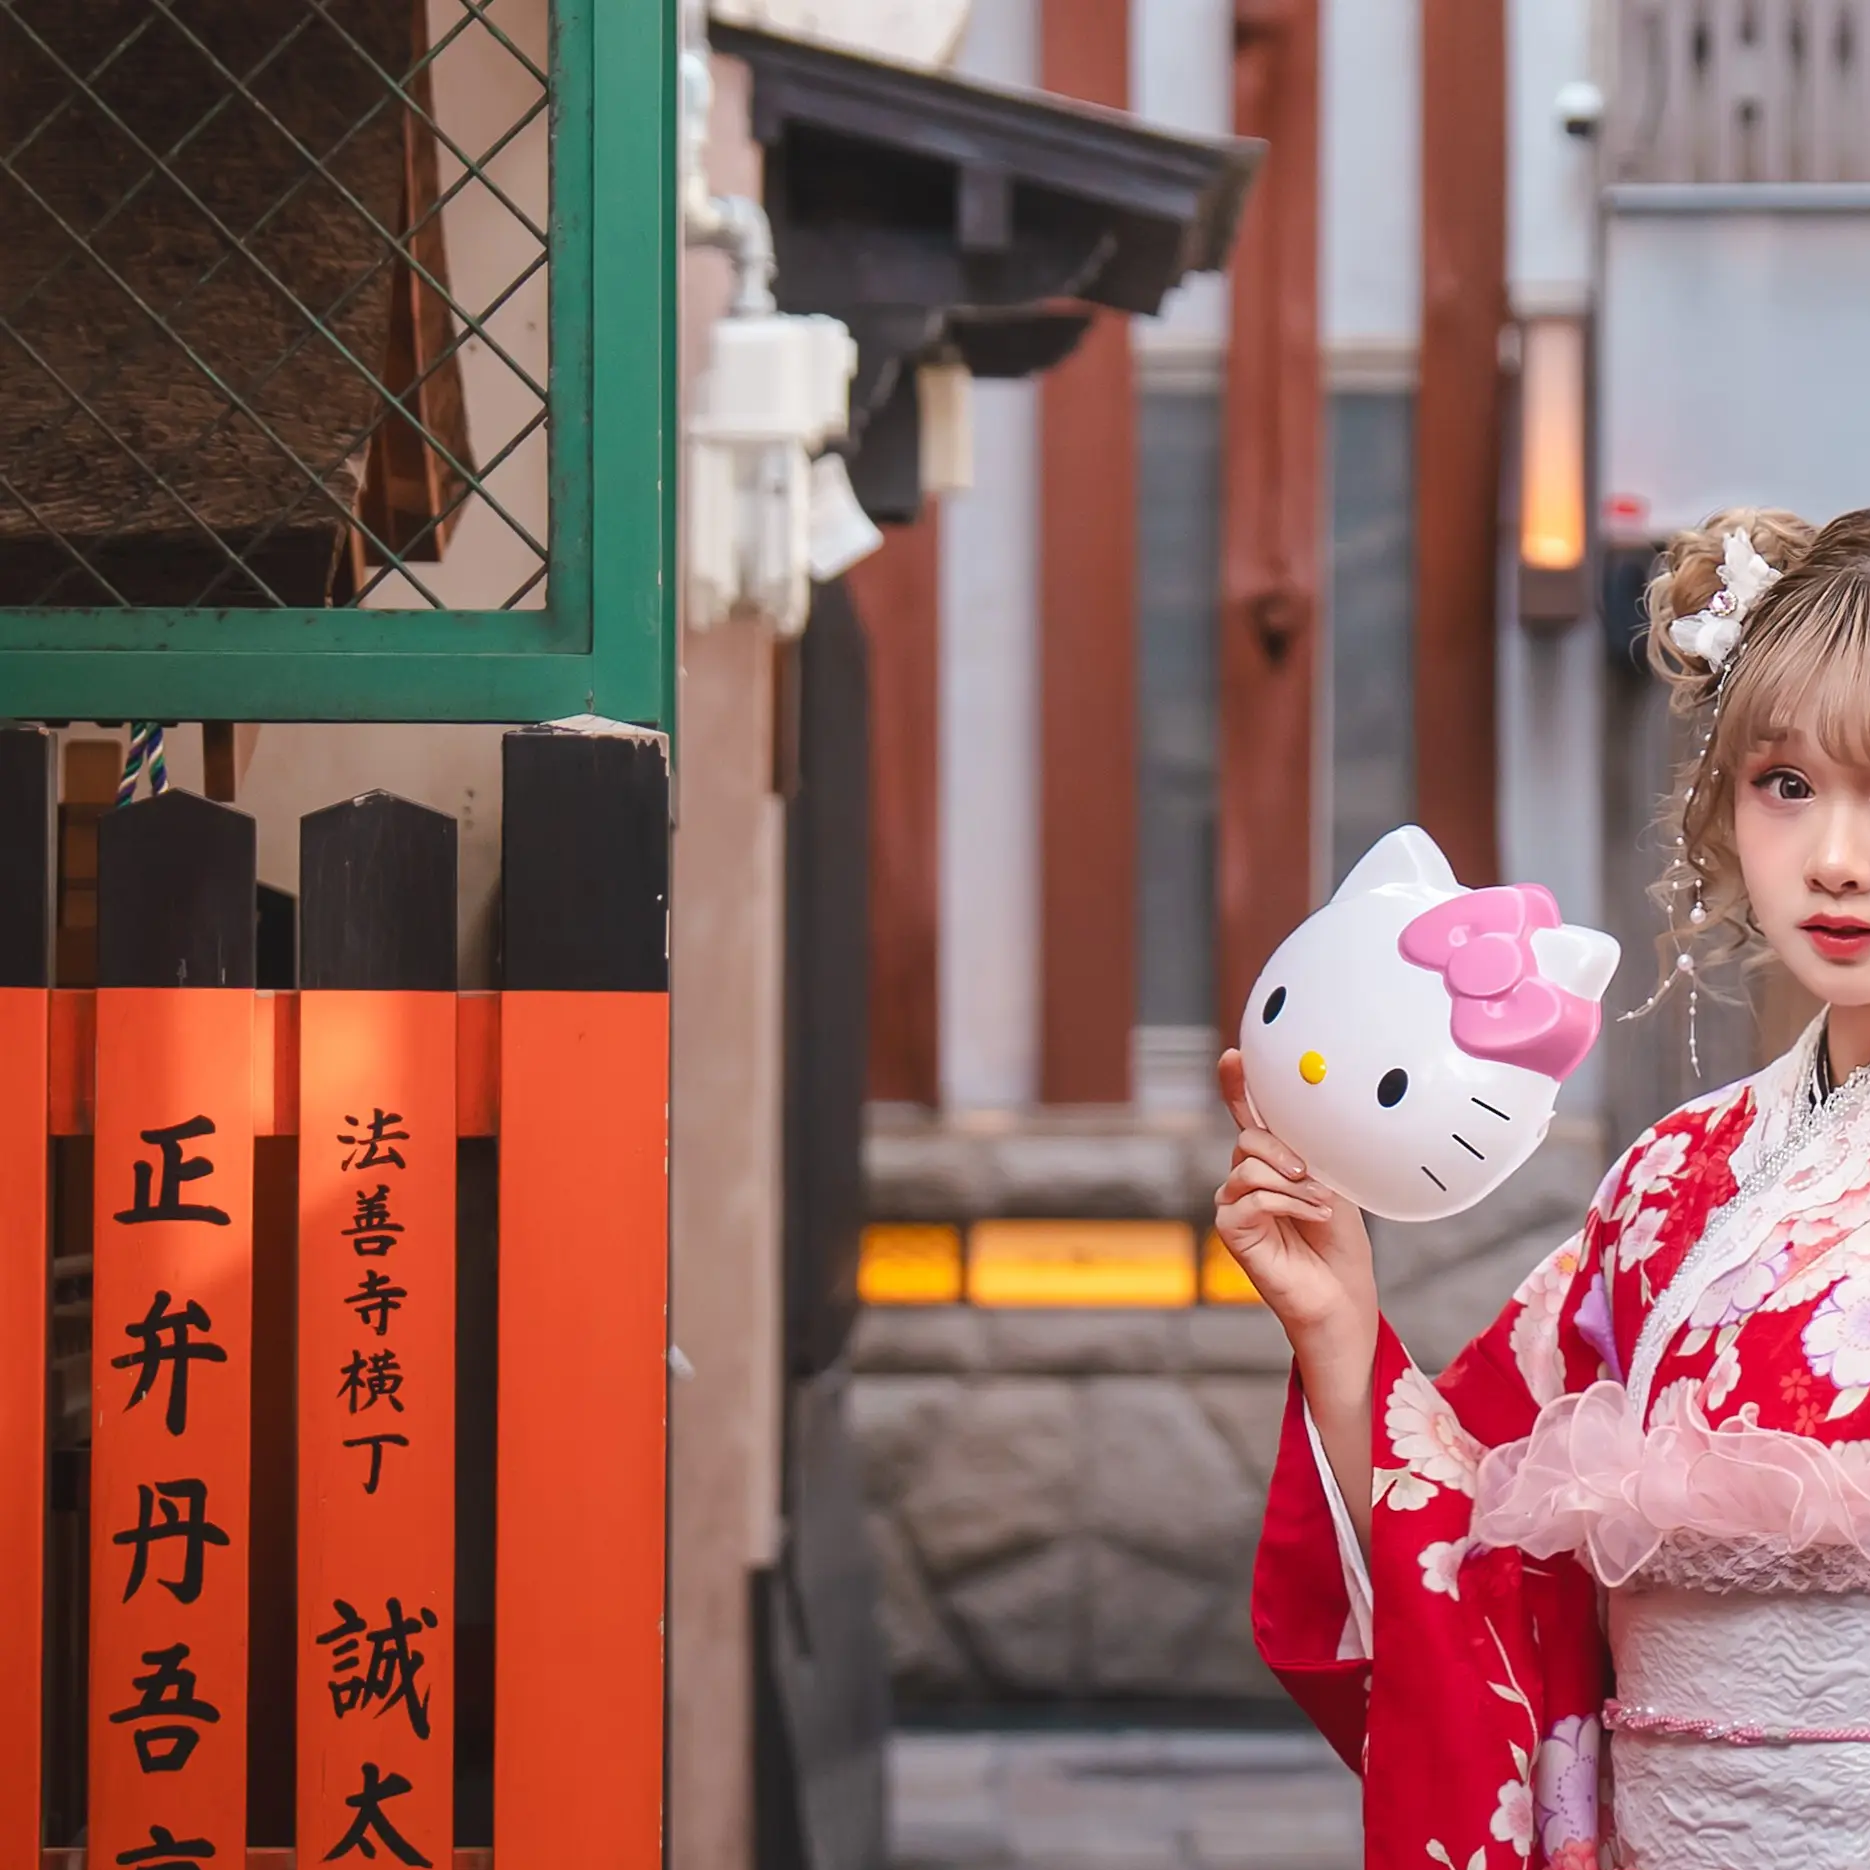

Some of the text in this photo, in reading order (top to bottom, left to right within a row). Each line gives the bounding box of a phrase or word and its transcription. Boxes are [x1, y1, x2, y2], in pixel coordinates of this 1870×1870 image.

[336, 1107, 411, 1496] 法善寺横丁
